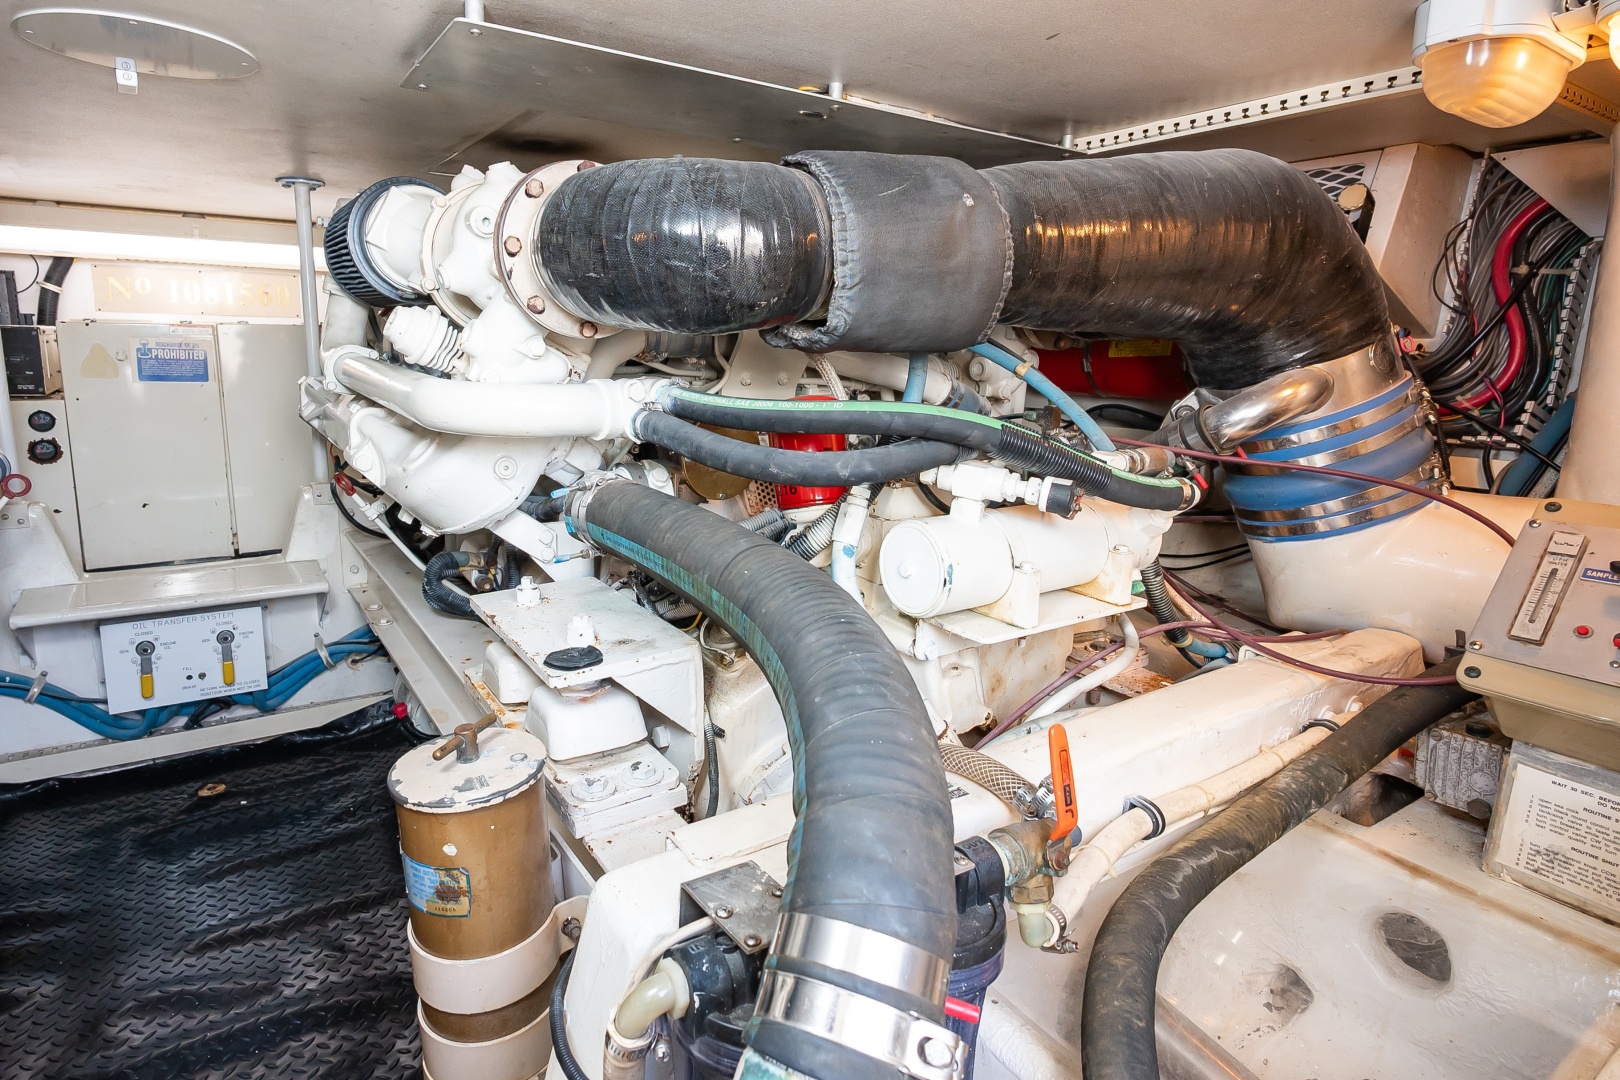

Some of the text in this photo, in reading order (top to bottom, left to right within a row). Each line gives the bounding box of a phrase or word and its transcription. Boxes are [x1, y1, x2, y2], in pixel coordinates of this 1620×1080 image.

[168, 279, 291, 307] 1081560
[151, 348, 205, 360] PROHIBITED
[1586, 570, 1618, 580] SAMPLE
[132, 611, 234, 630] OIL TRANSFER SYSTEM
[1551, 780, 1568, 789] WAIT
[1580, 790, 1596, 798] SEC.
[1537, 802, 1552, 811] open
[1554, 808, 1569, 816] black
[1570, 814, 1588, 823] round
[1590, 821, 1610, 831] control
[1565, 807, 1579, 815] cock
[1583, 807, 1612, 821] ROUTINE
[1560, 820, 1582, 832] breaker
[1584, 830, 1600, 839] while
[1567, 819, 1583, 827] valve
[1548, 828, 1565, 837] water
[1567, 835, 1587, 846] quality
[1590, 843, 1602, 851] and
[1605, 848, 1617, 856] turn
[1549, 823, 1570, 833] control
[1571, 831, 1588, 840] valve
[1590, 837, 1602, 845] CW
[1570, 846, 1600, 861] ROUTINE
[1561, 854, 1582, 864] control
[1583, 862, 1598, 871] knob
[1600, 869, 1617, 879] CCW
[1573, 870, 1589, 878] valve
[1551, 877, 1565, 885] cock
[1557, 869, 1578, 879] control
[1580, 878, 1595, 886] knob
[1566, 877, 1582, 886] valve
